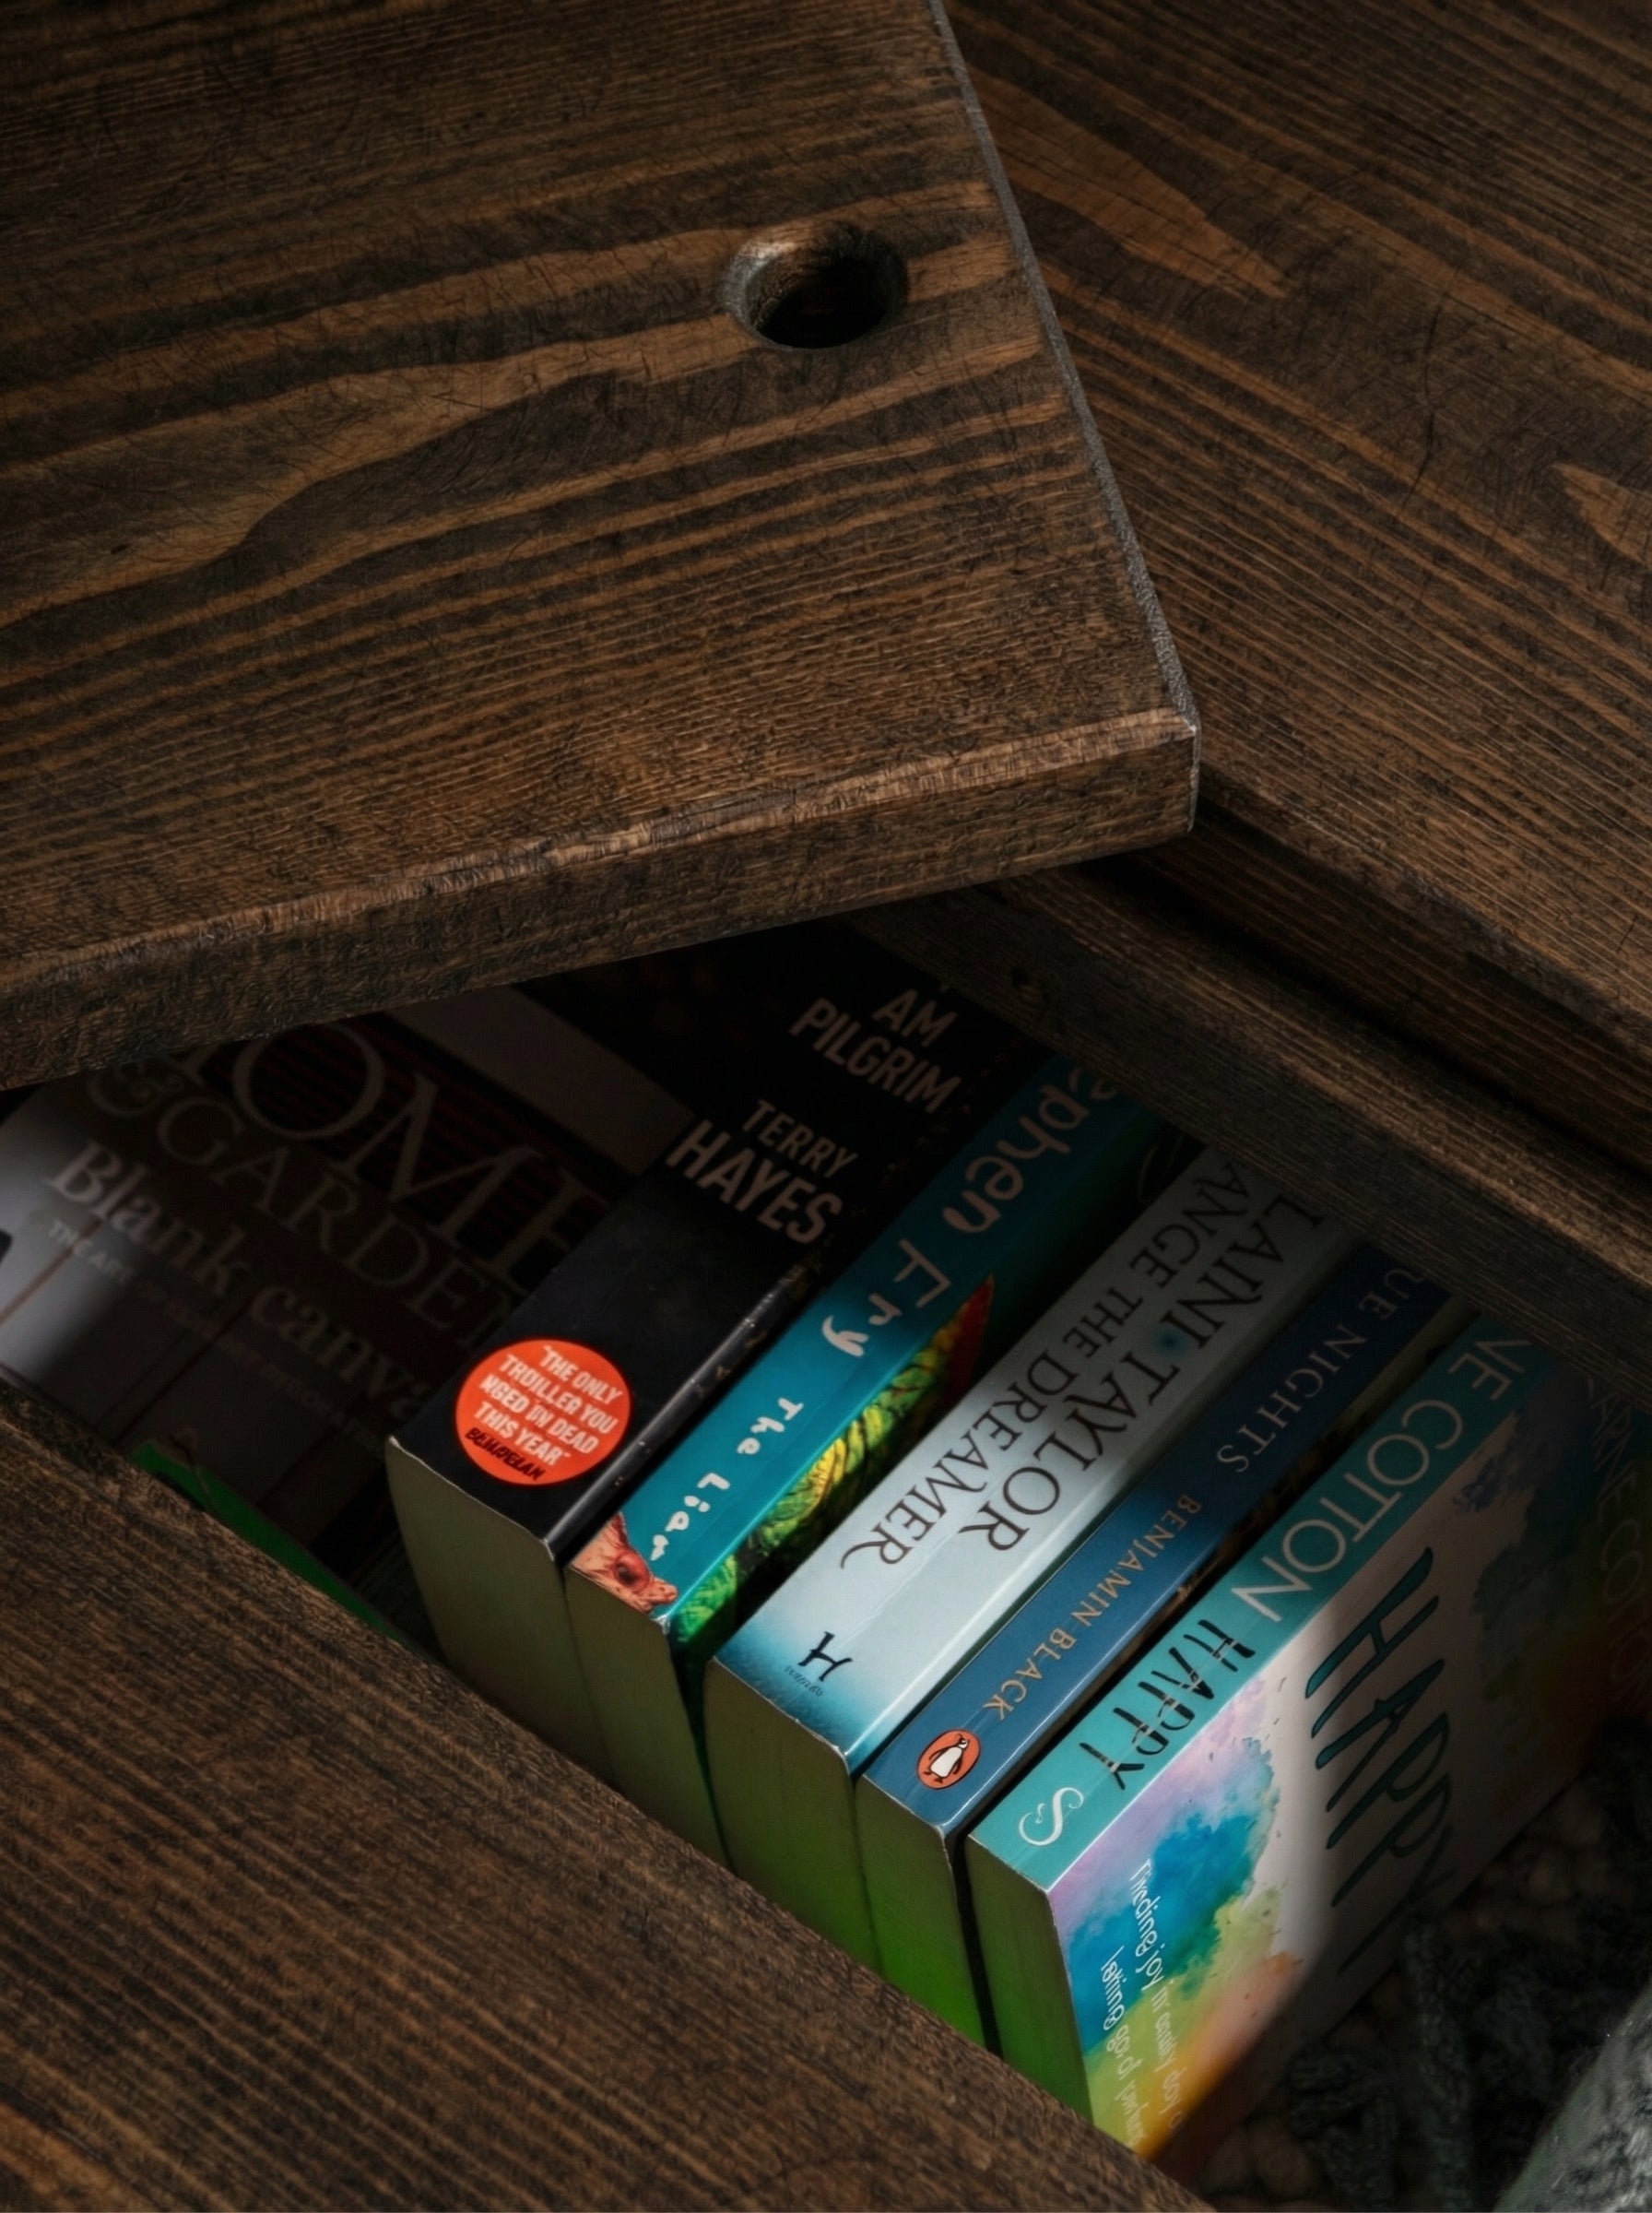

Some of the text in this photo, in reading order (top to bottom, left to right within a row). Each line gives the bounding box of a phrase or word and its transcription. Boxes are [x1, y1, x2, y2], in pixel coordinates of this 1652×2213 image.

[788, 995, 963, 1116] PILGRIM
[871, 988, 959, 1049] AM
[664, 1118, 845, 1246] HAYES
[740, 1097, 860, 1181] TERRY
[46, 1139, 252, 1296] Blank
[821, 1237, 952, 1357] Fry
[1064, 1287, 1143, 1358] THE
[474, 1401, 519, 1438] THIS
[572, 1371, 623, 1405] ONLY
[579, 1403, 620, 1434] YOU
[959, 1193, 1326, 1551] LAINI TAYLOR
[1216, 1323, 1368, 1473] NIGHTS
[649, 1397, 804, 1561] The Liar
[841, 1349, 1077, 1568] DREAMER
[1231, 1399, 1464, 1623] COTTON
[983, 1494, 1202, 1721] BENJAMIN BLACK
[1080, 1619, 1255, 1790] HAPPY
[1305, 1546, 1458, 1977] HAPPY
[1134, 1943, 1165, 1992] joy
